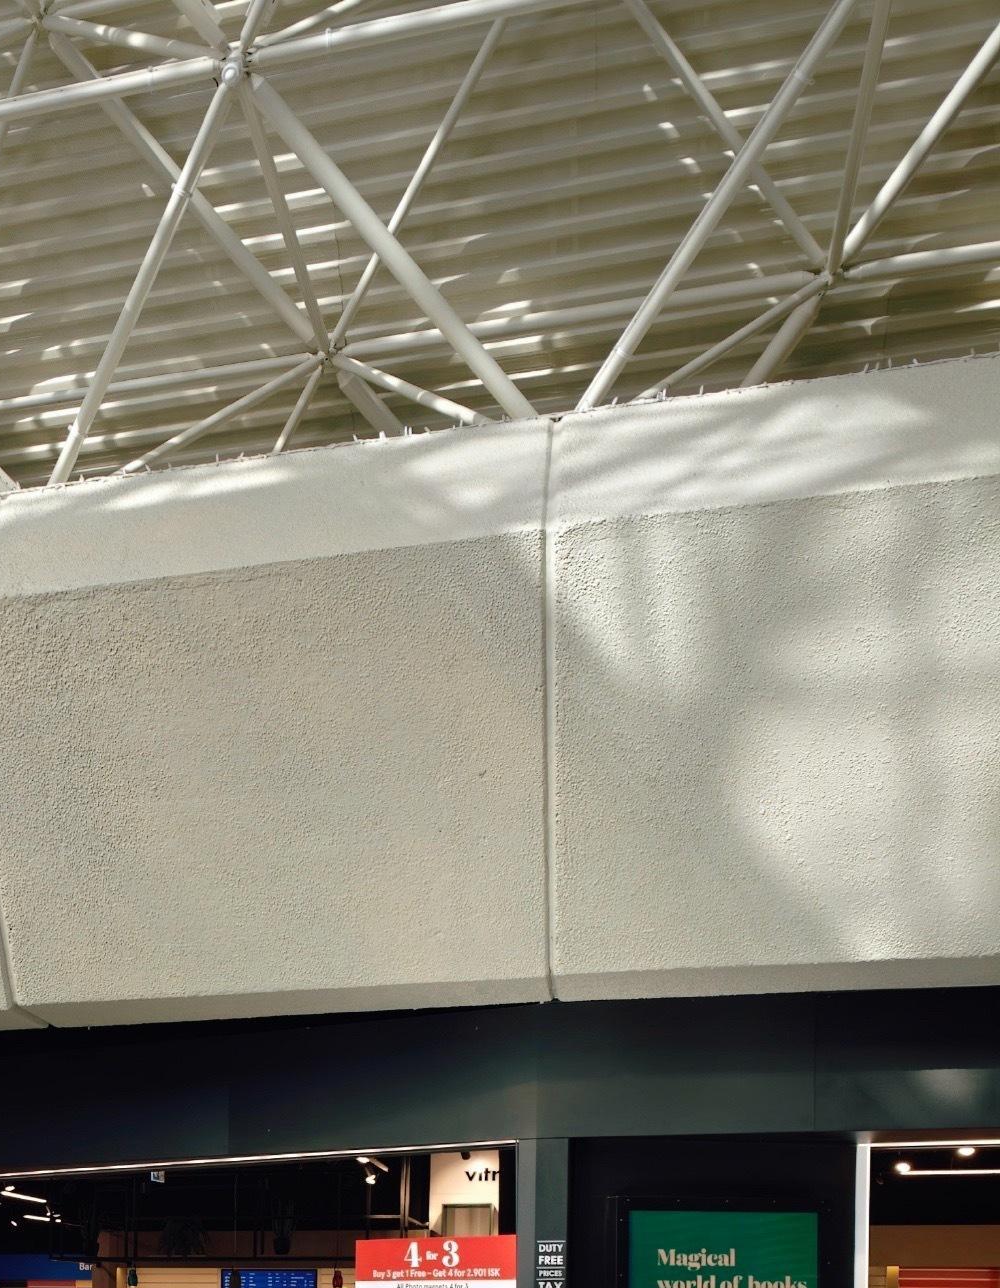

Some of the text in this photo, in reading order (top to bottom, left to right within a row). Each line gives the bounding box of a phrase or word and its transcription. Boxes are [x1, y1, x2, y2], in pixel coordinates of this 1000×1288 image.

[538, 1244, 563, 1253] DUTY
[404, 1240, 460, 1268] 4 for 3
[538, 1255, 564, 1265] FREE
[657, 1248, 736, 1271] Magical
[372, 1270, 386, 1279] Buy
[392, 1270, 405, 1279] get
[410, 1269, 427, 1278] Free
[432, 1269, 447, 1278] Get
[447, 1269, 453, 1278] 4
[453, 1268, 466, 1278] for
[487, 1268, 501, 1278] ISK
[538, 1269, 563, 1277] PRICES
